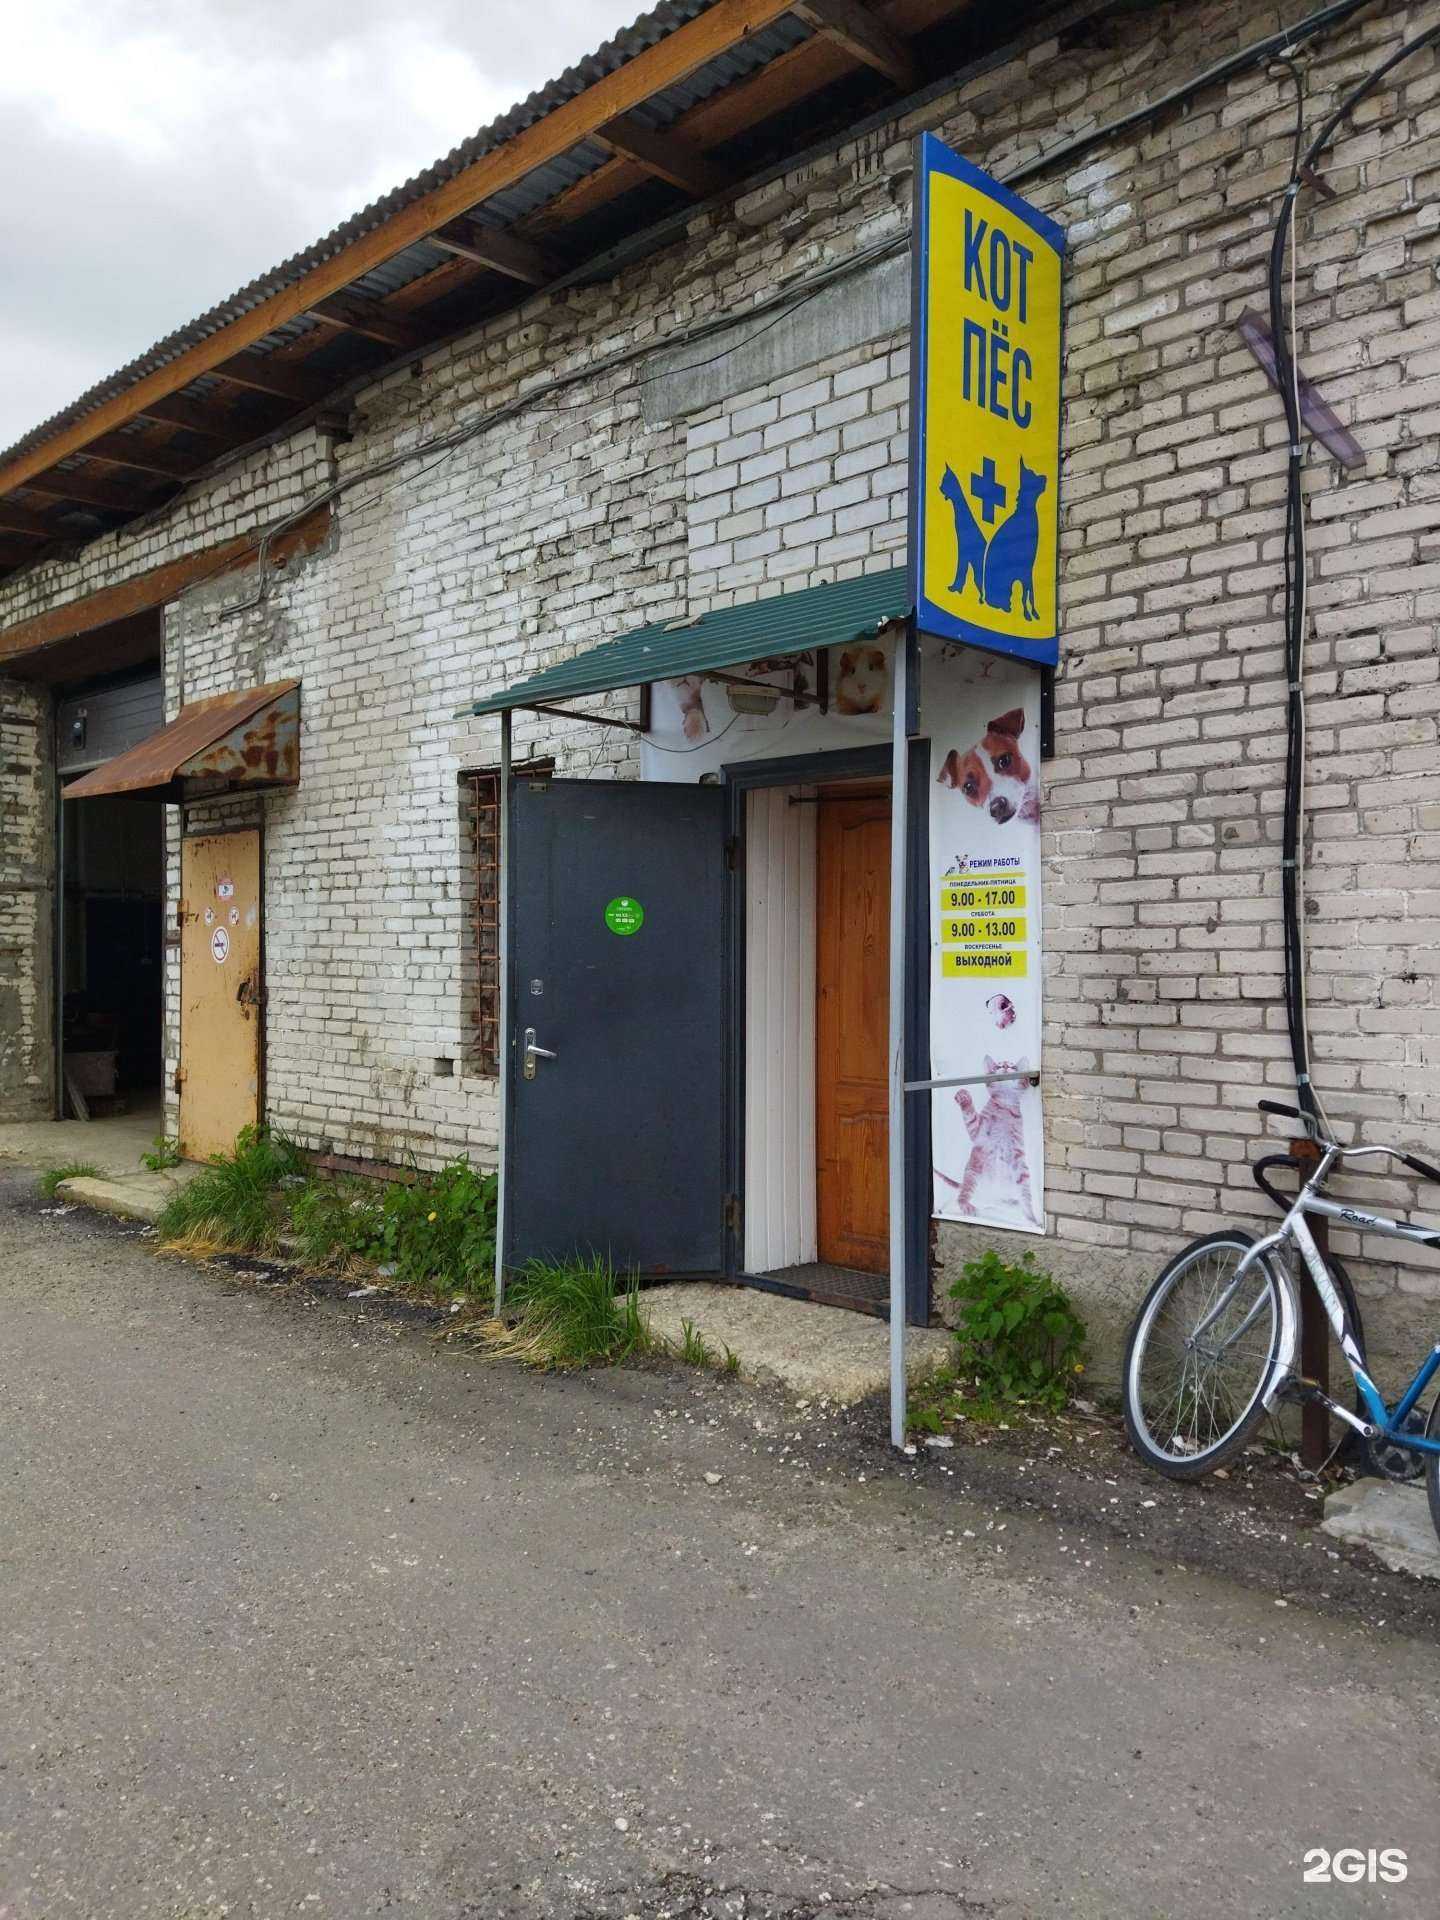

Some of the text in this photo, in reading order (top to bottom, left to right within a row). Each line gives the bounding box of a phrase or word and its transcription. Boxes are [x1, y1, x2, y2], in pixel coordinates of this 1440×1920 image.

[964, 208, 1033, 325] КОТ
[963, 318, 1032, 429] ПЁС
[970, 857, 1020, 868] РЕЖИМ РАБОТЫ
[951, 892, 974, 906] 9.00
[985, 891, 1015, 905] 17.00
[952, 923, 975, 937] 9.00
[986, 922, 1016, 936] 13.00
[956, 953, 1012, 968] ВЫХОДНОЙ
